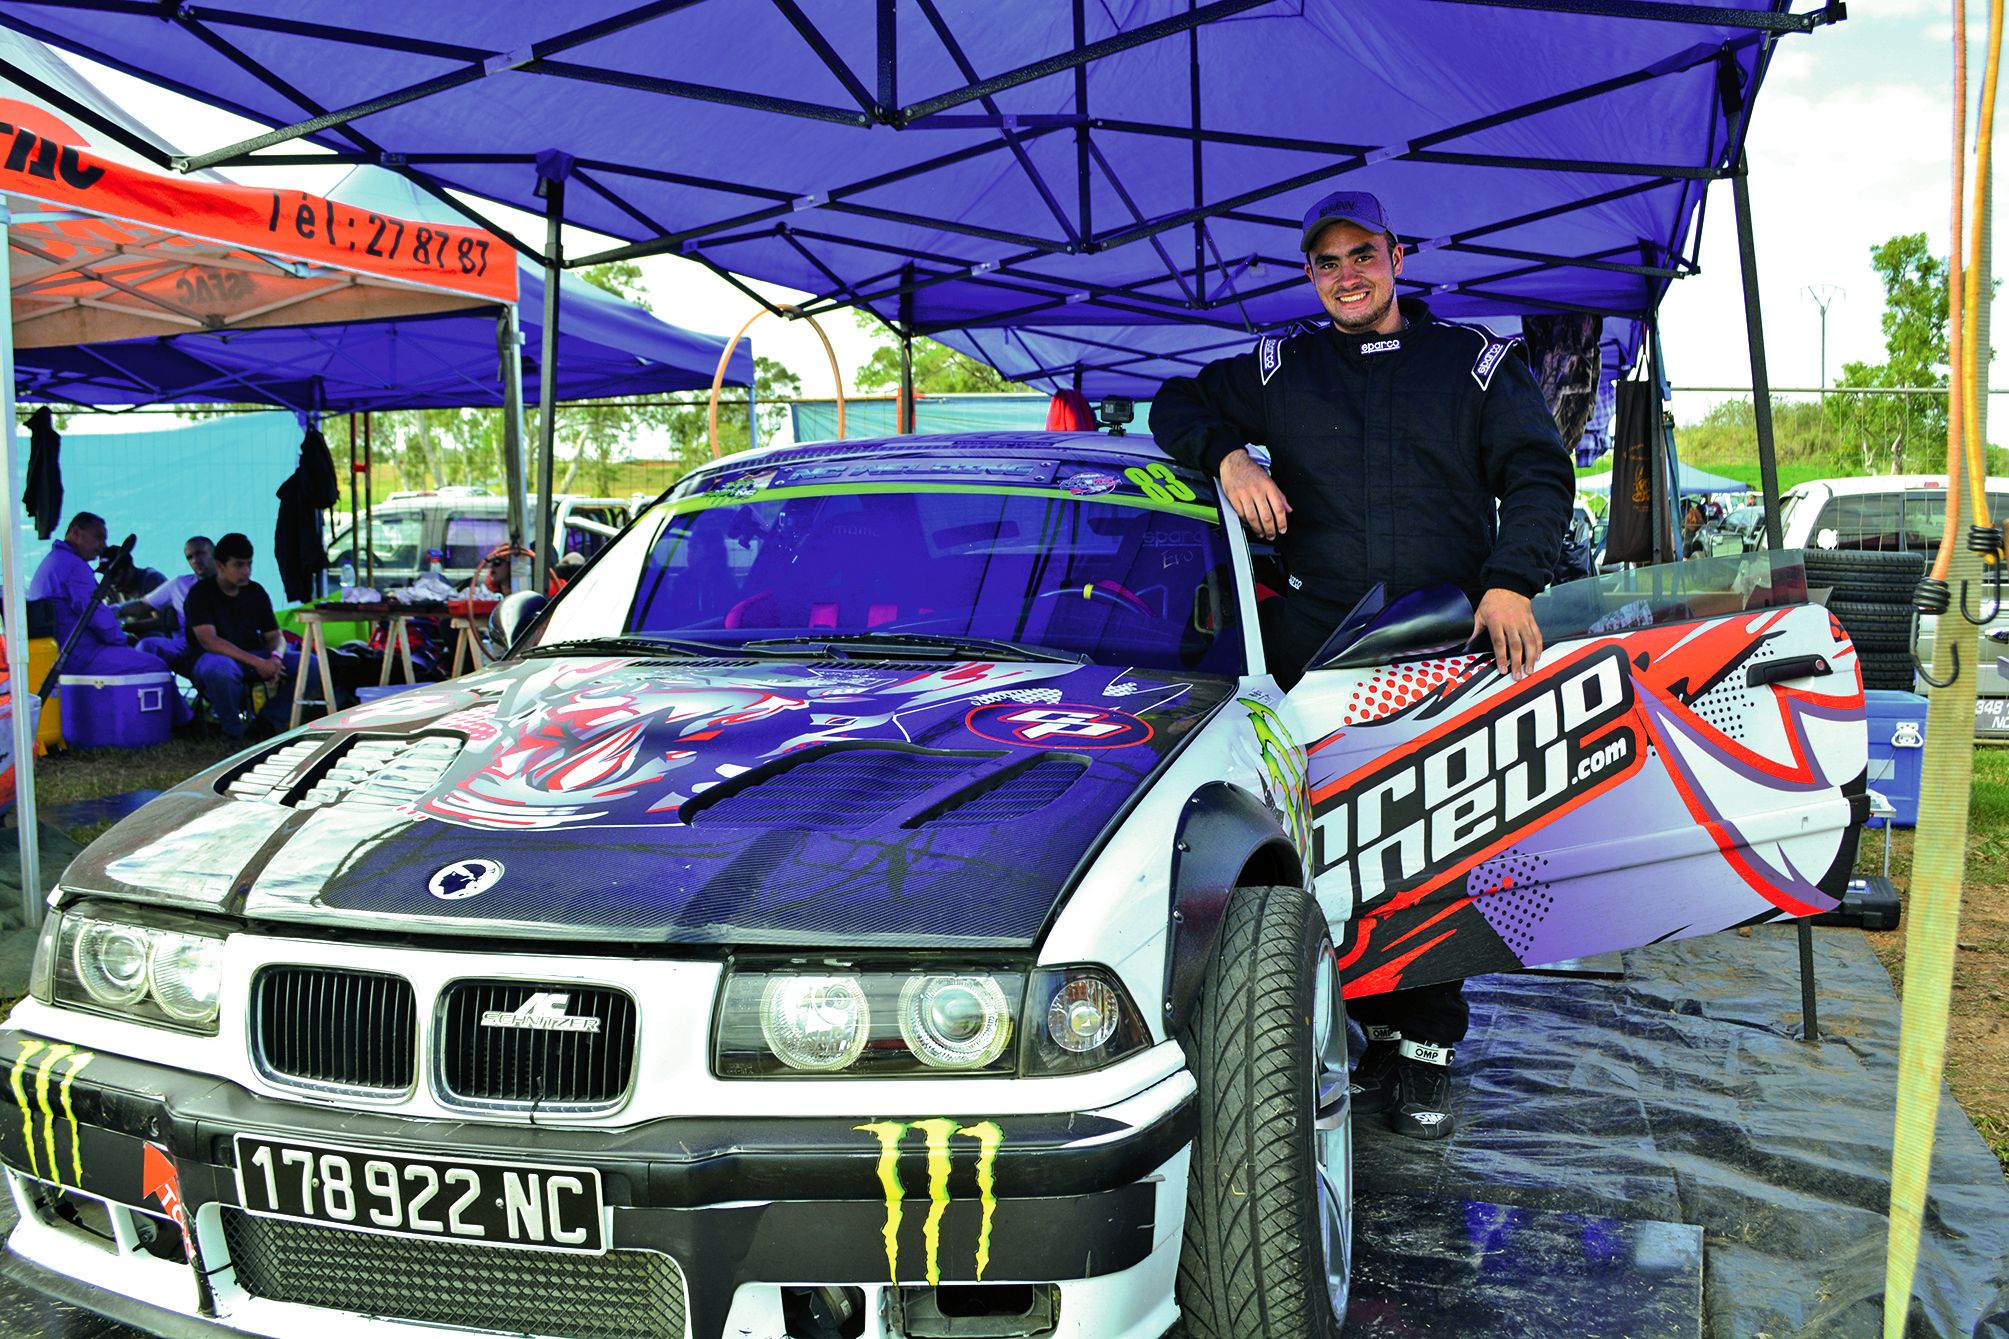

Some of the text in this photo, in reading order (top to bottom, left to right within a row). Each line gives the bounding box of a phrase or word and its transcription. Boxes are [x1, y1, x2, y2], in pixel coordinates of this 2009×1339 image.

[1361, 339, 1400, 355] sparco
[1477, 343, 1504, 376] sparco
[1124, 462, 1197, 506] 83
[1974, 700, 2004, 715] 348
[514, 992, 571, 1016] AC
[481, 1010, 601, 1034] SCHNITZER
[1415, 1048, 1439, 1060] OMP
[251, 1146, 588, 1245] 178 922 NC
